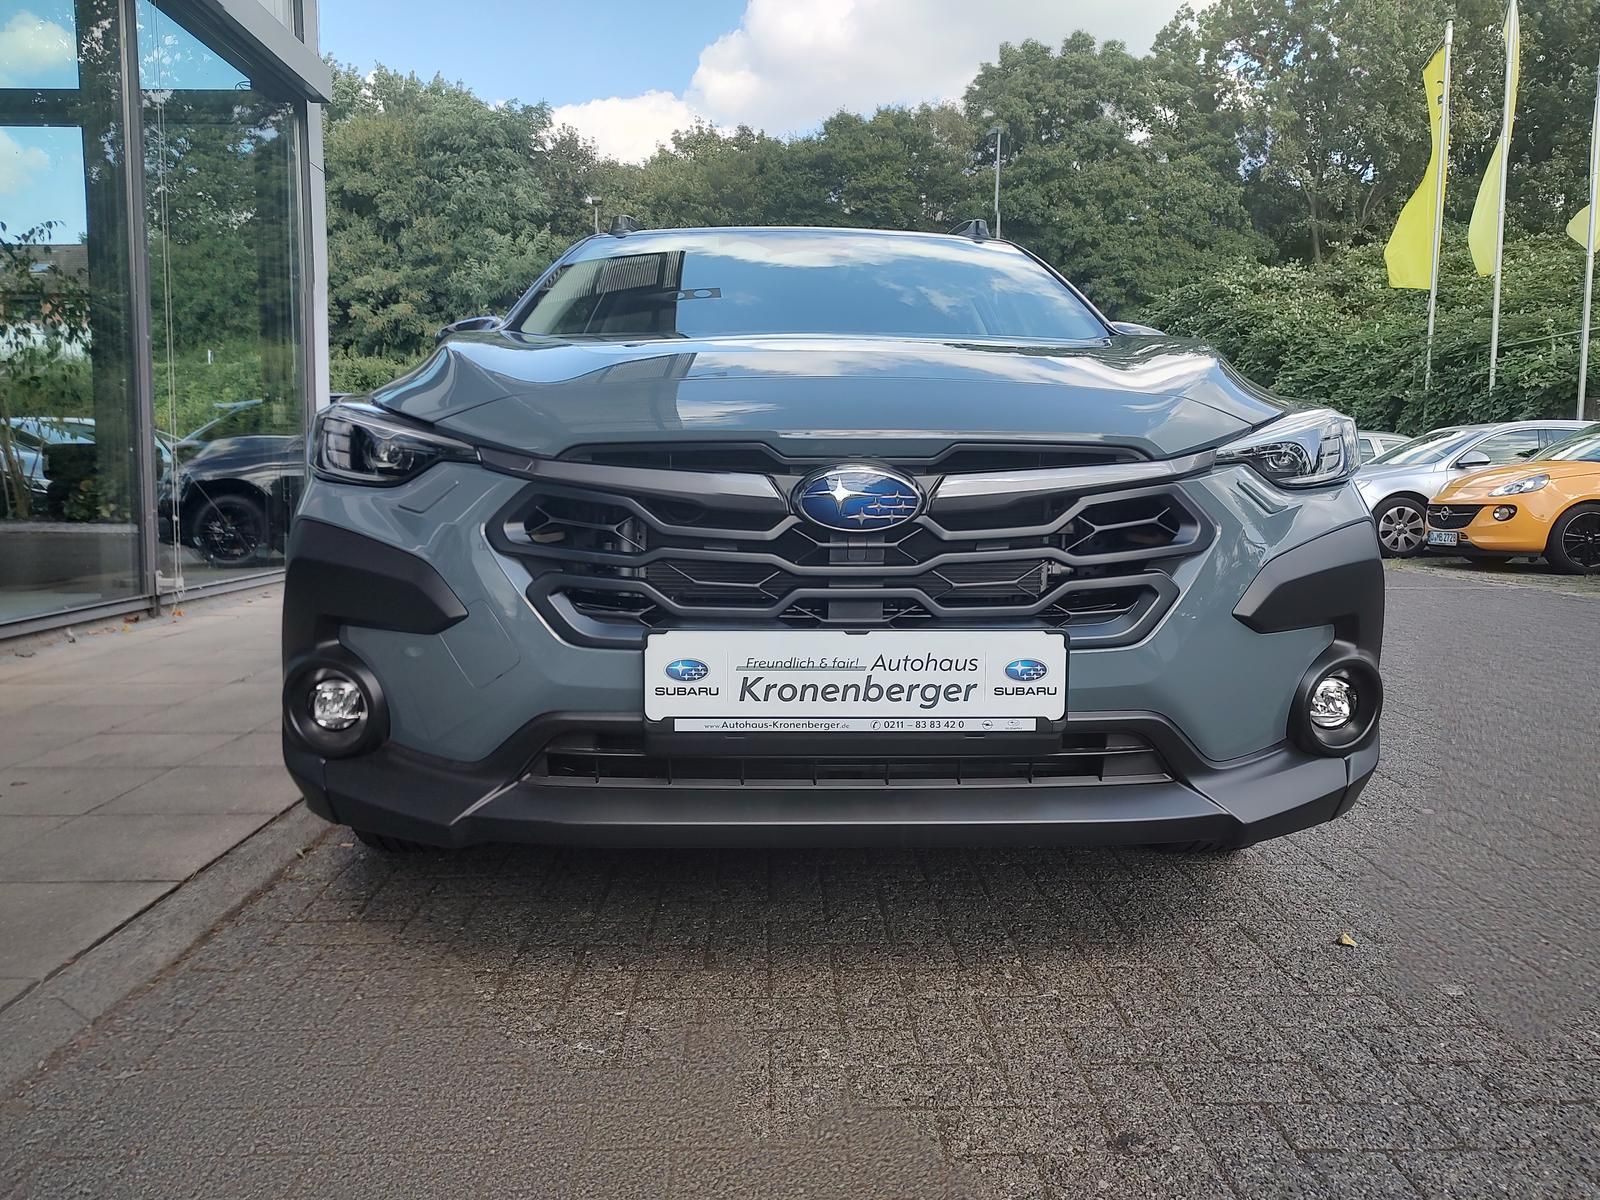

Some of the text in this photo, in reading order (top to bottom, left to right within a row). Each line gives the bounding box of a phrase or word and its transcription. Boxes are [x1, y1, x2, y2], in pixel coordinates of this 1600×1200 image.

[746, 657, 859, 669] Freundlich & fair!
[870, 652, 978, 672] Autohaus
[655, 687, 719, 696] SUBARU
[739, 675, 978, 709] Kronenberger
[994, 687, 1057, 696] SUBARU
[704, 720, 850, 731] www.Autohaus-Kronenberger.de
[883, 720, 904, 729] 0211
[915, 720, 927, 729] 83
[929, 720, 941, 729] 83
[943, 720, 956, 729] 42
[958, 720, 965, 729] 0
